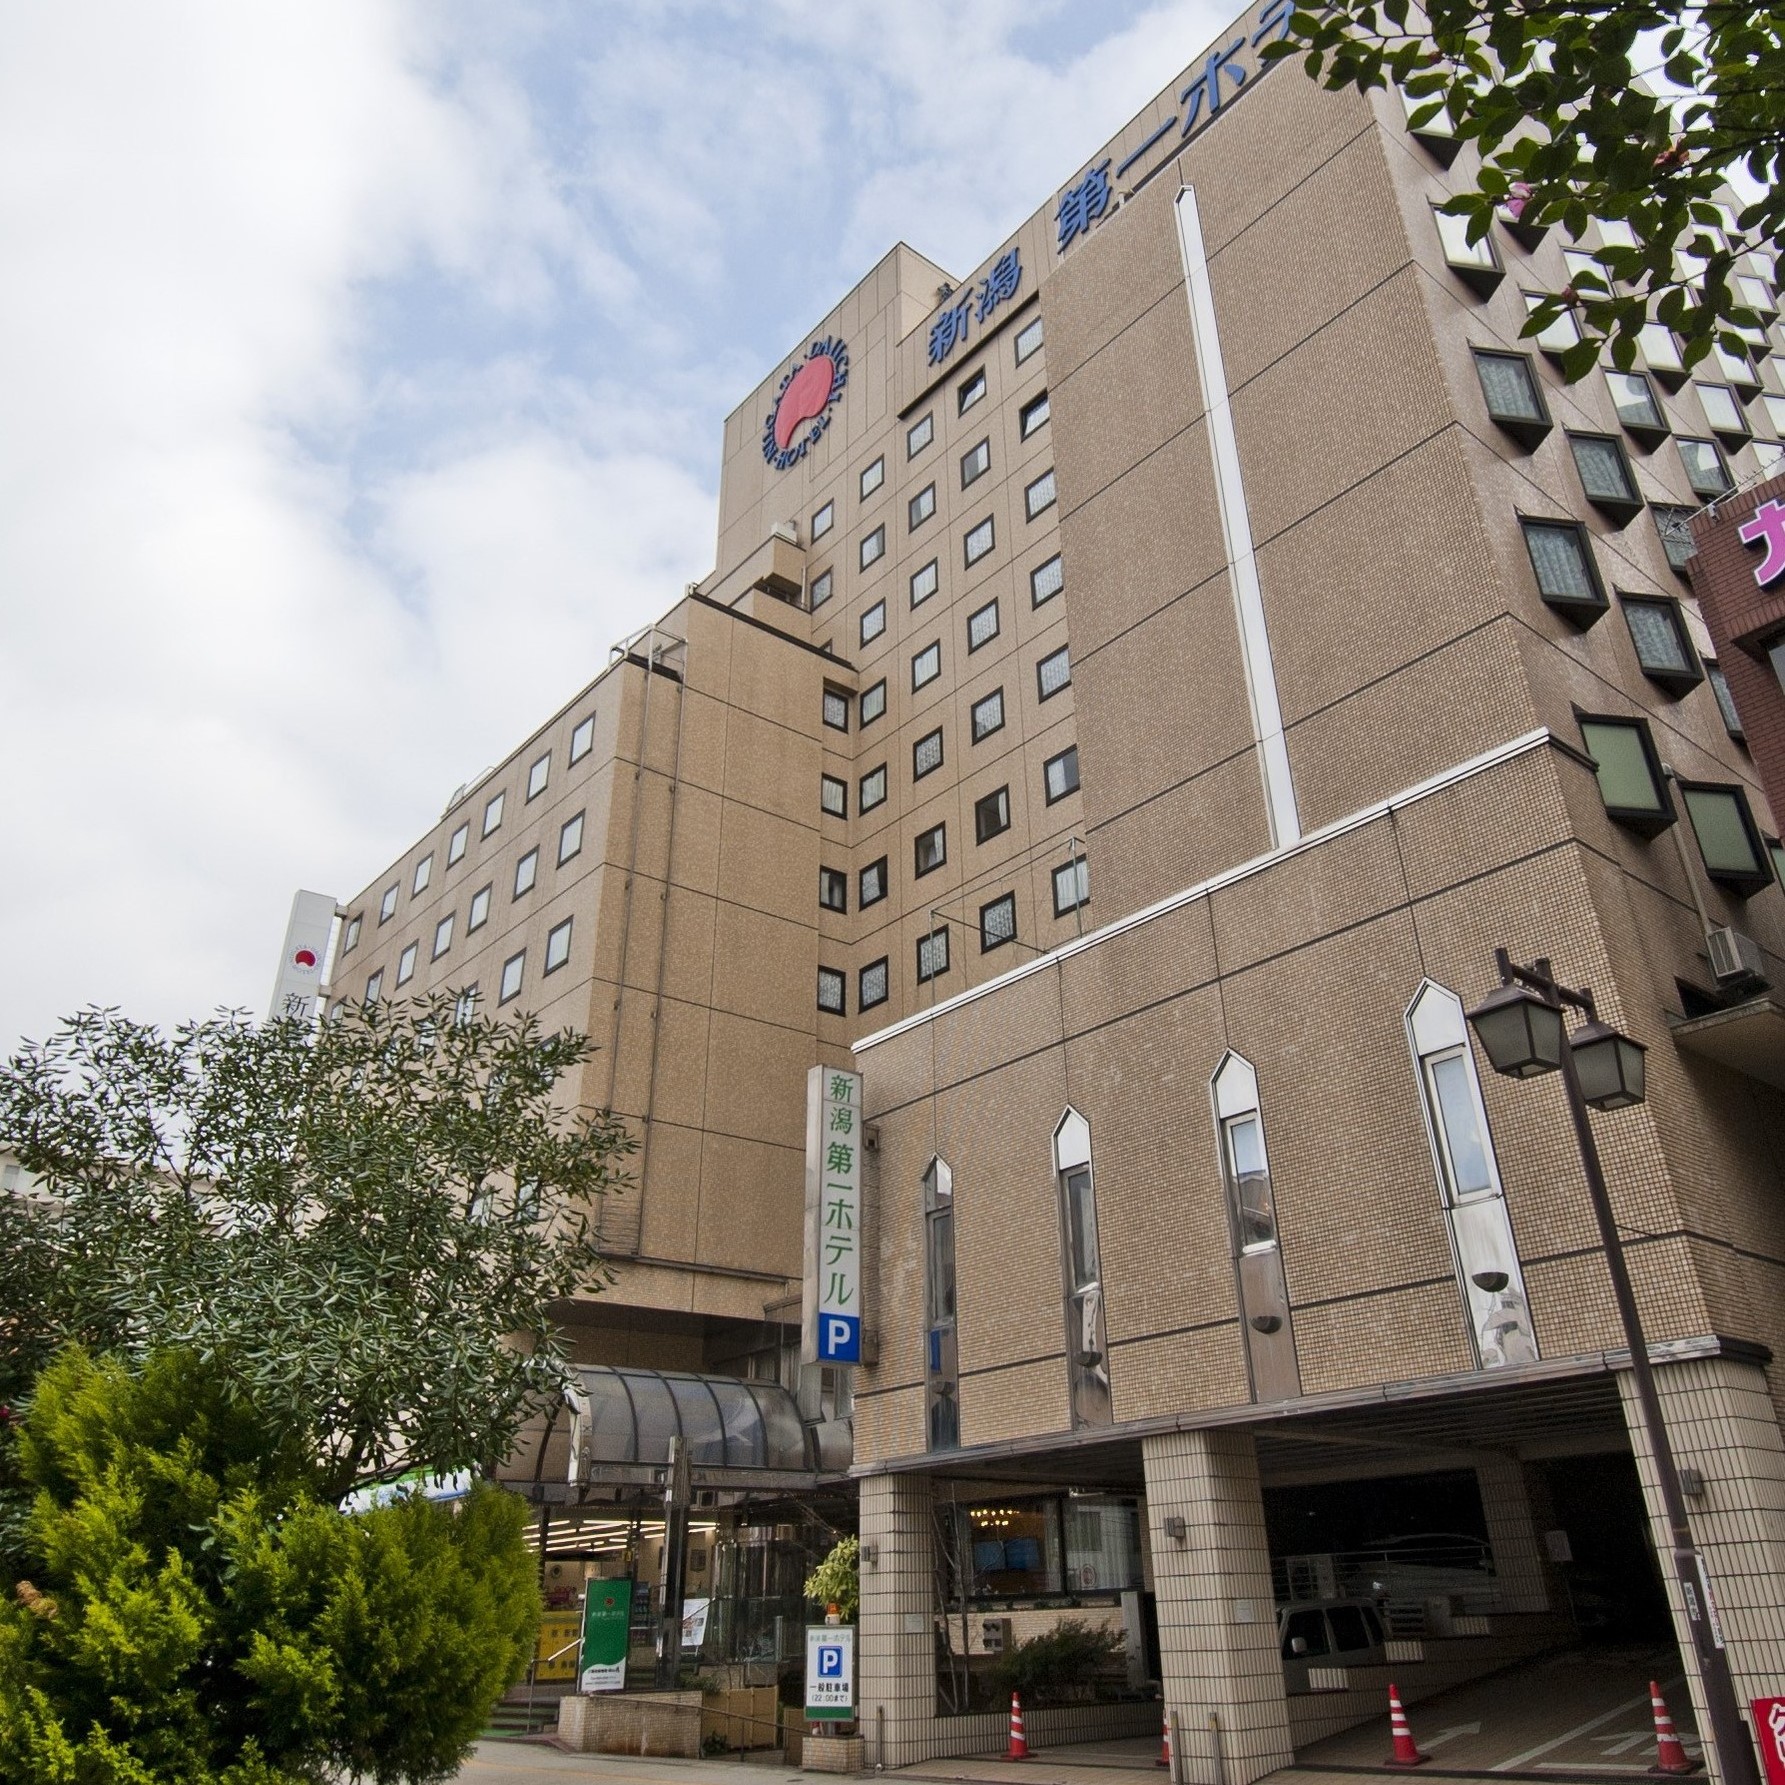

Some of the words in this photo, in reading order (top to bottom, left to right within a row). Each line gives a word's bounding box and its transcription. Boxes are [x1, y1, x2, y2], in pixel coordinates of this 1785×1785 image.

[774, 414, 833, 471] HOTEL
[823, 1074, 855, 1306] 新潟第一ホテル
[827, 1319, 851, 1355] P
[822, 1649, 839, 1674] P
[809, 1682, 849, 1693] 一般駐車場
